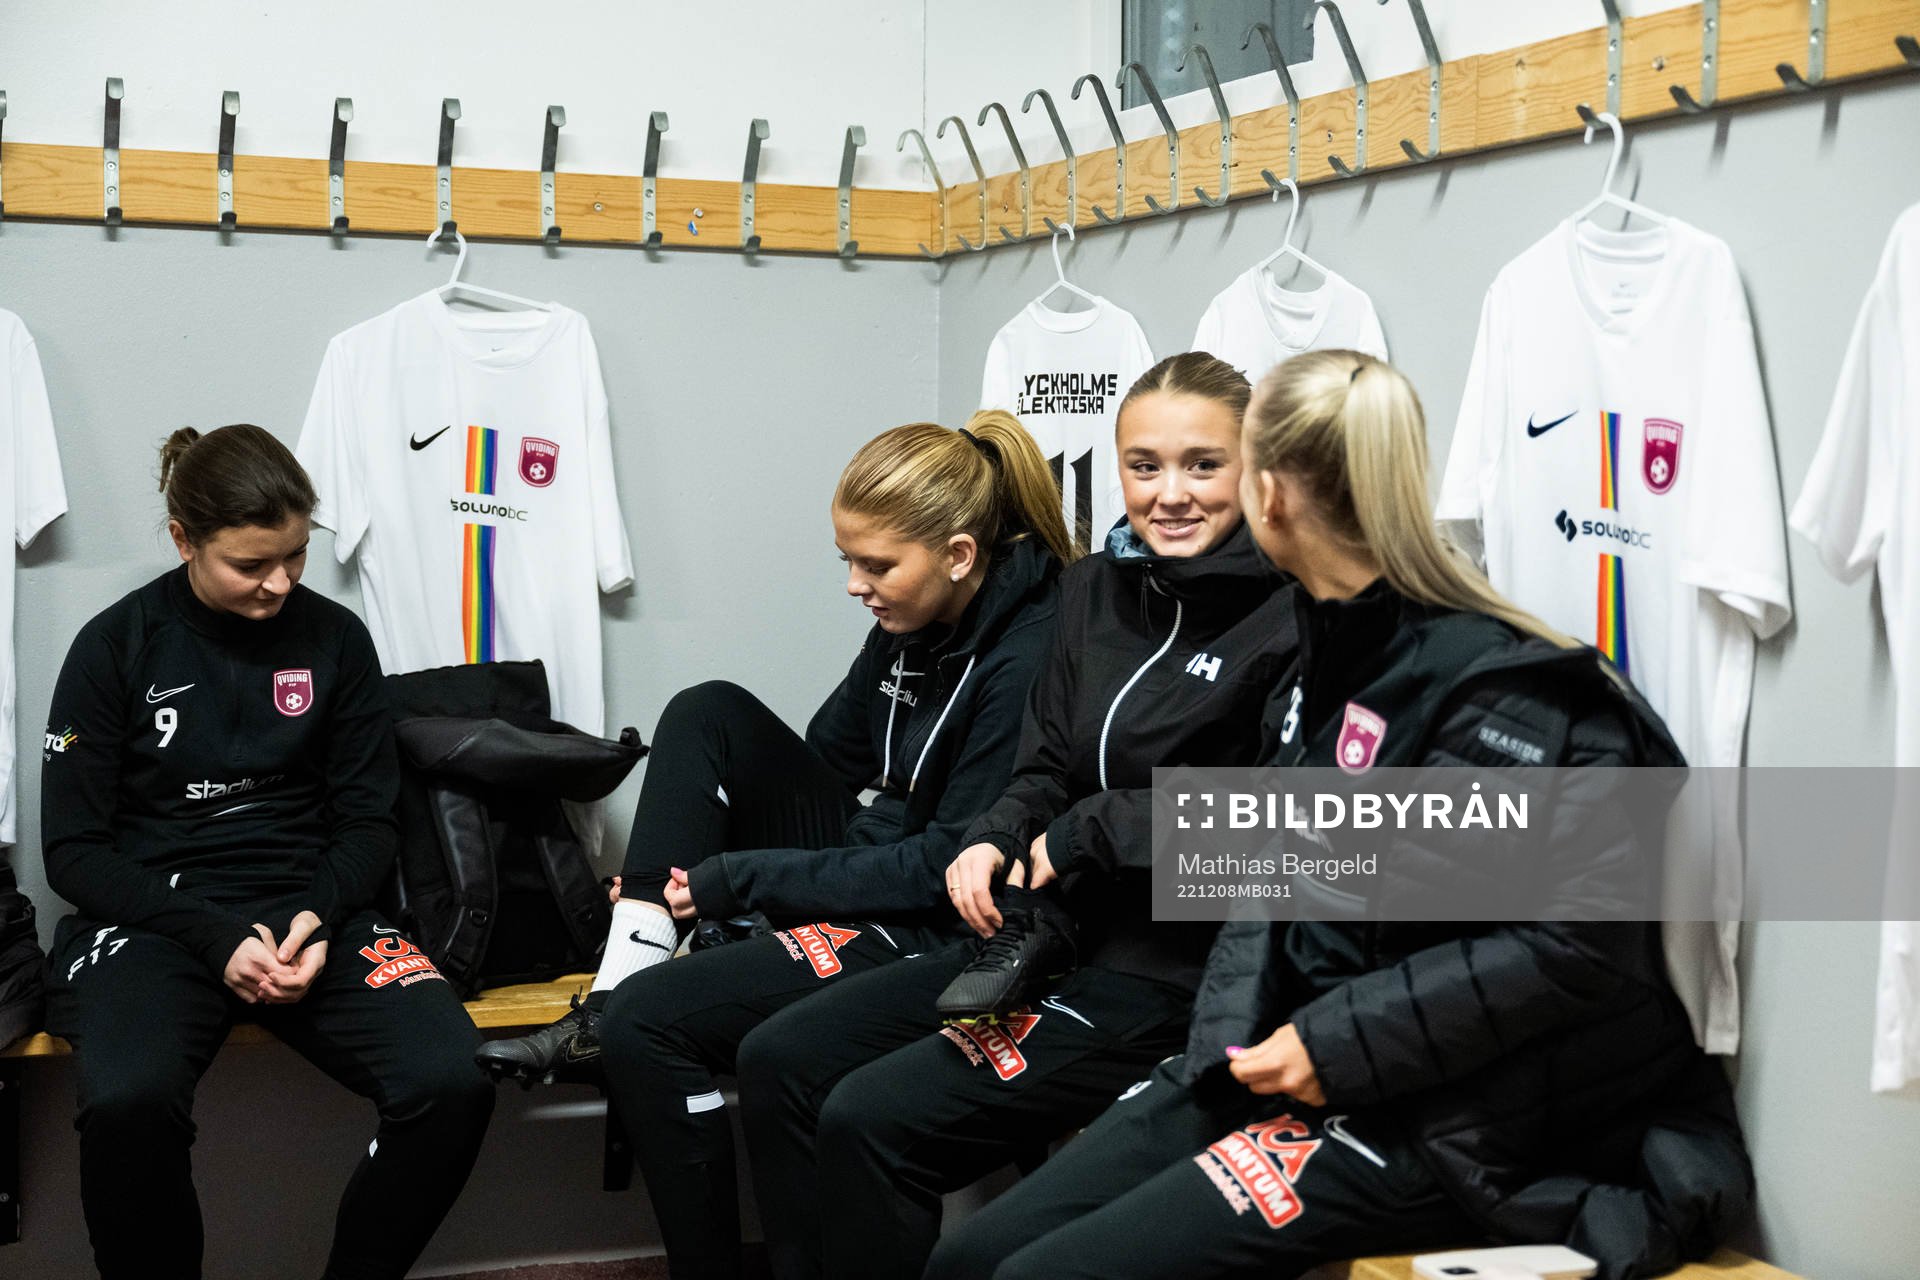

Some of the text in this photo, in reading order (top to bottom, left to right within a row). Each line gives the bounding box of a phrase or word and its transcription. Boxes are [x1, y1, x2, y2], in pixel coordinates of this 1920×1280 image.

[1018, 373, 1118, 398] YCKHOLMS
[1017, 396, 1105, 416] LEKTRISKA
[276, 672, 308, 687] QVIDING
[154, 707, 178, 748] 9
[795, 926, 836, 972] NTUM
[372, 957, 431, 985] KVANT
